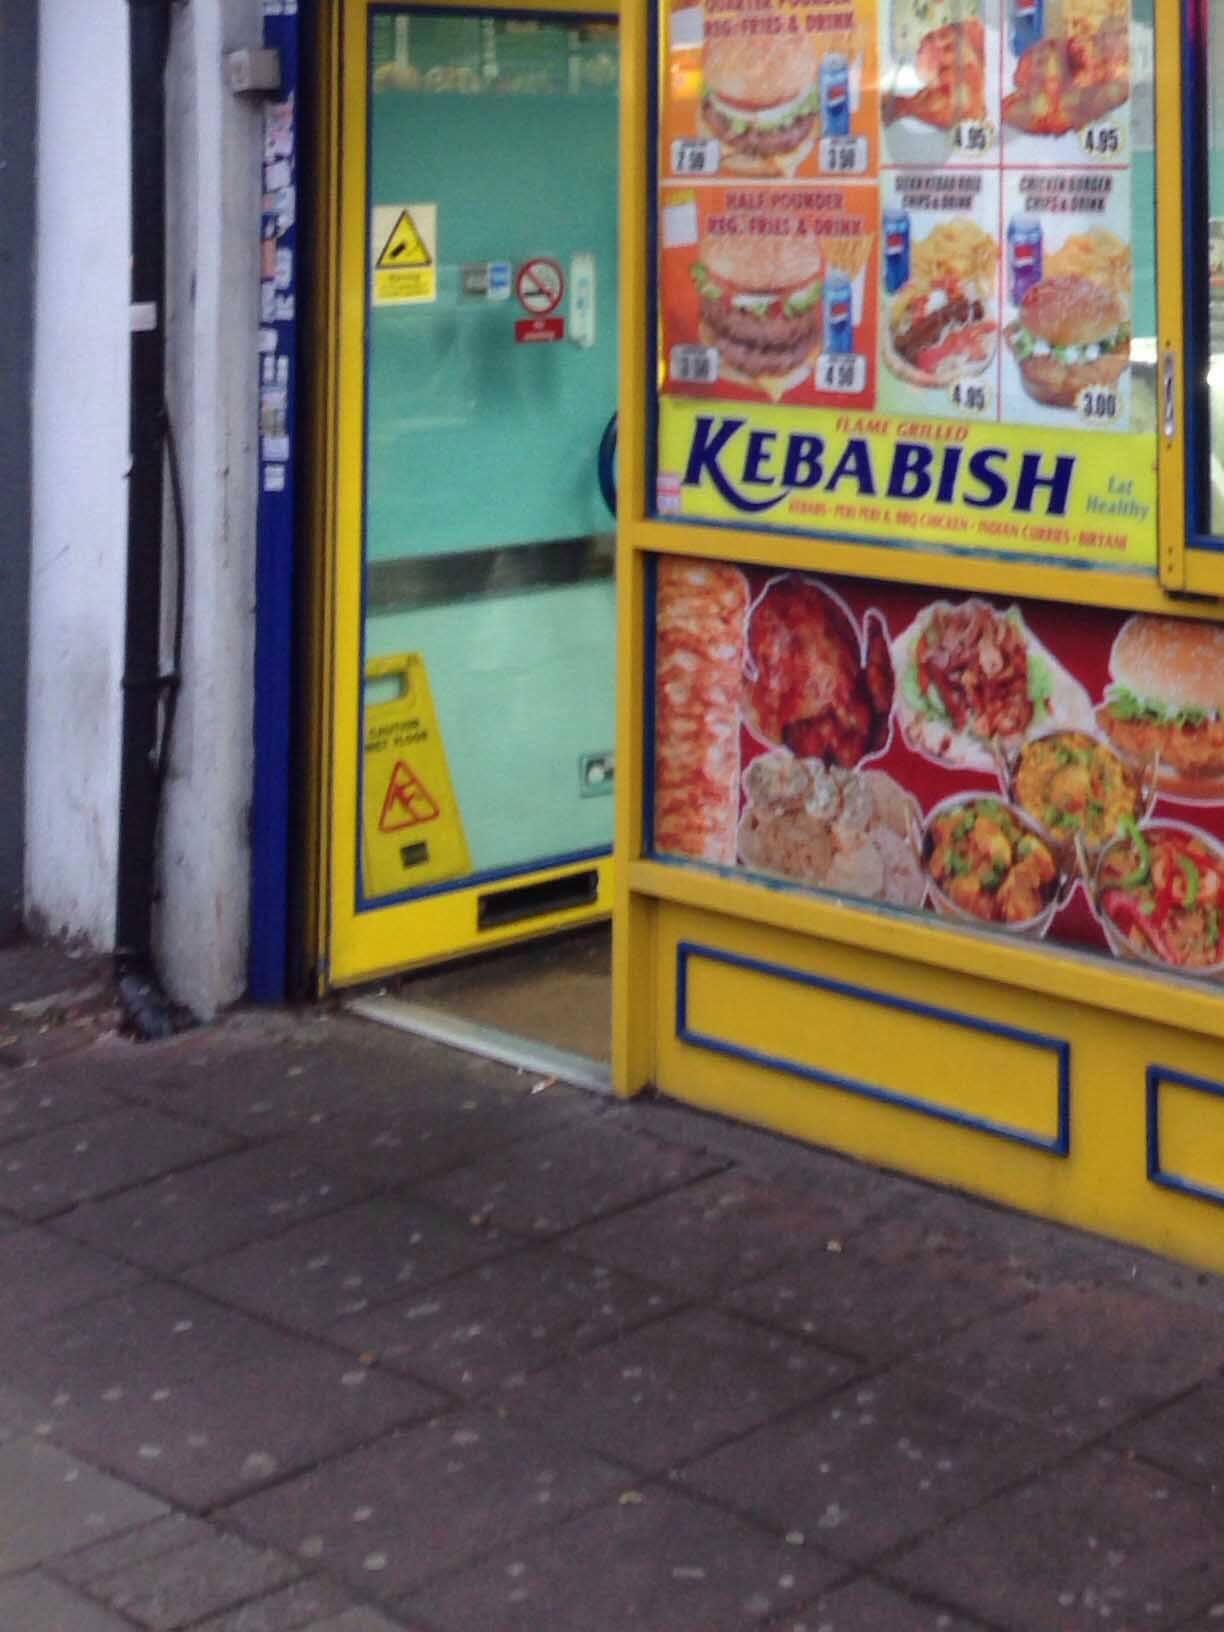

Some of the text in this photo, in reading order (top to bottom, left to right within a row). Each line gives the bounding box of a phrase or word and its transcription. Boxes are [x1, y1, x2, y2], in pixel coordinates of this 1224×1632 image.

[1085, 128, 1119, 154] 4.95
[726, 191, 843, 209] HALF POUNDER
[814, 218, 862, 235] DRINK
[836, 415, 968, 441] FLAME GRILLED
[682, 416, 1076, 515] KEBABISH
[1086, 495, 1150, 521] Healthy
